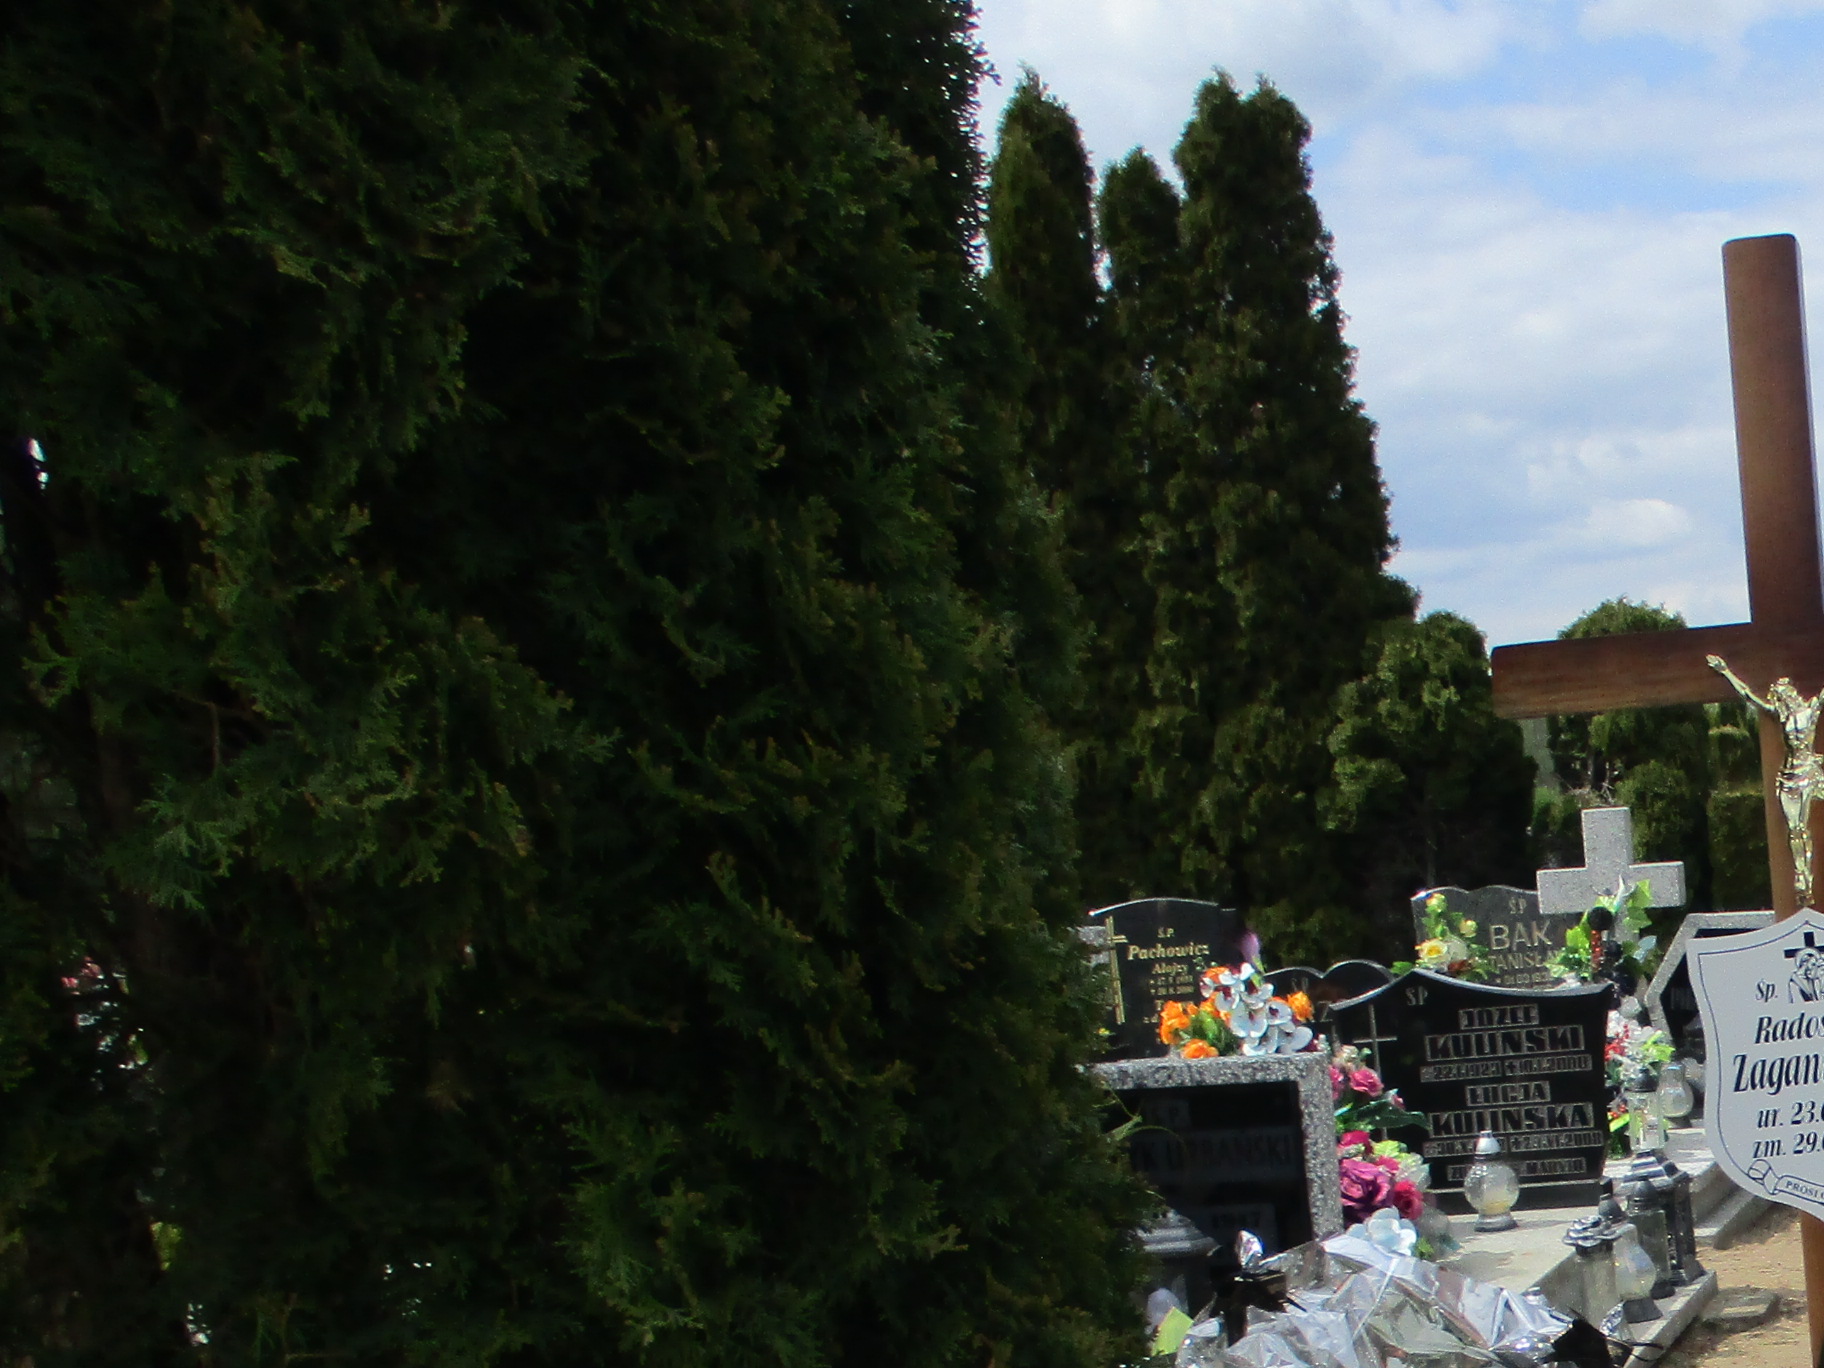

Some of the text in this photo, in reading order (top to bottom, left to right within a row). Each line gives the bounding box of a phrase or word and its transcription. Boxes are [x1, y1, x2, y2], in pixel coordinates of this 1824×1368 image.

[1489, 921, 1553, 950] BAK
[1127, 941, 1210, 960] Pachowicz
[1757, 1107, 1784, 1129] ur.
[1752, 1138, 1787, 1160] zm.
[1785, 1180, 1819, 1199] PROSI
